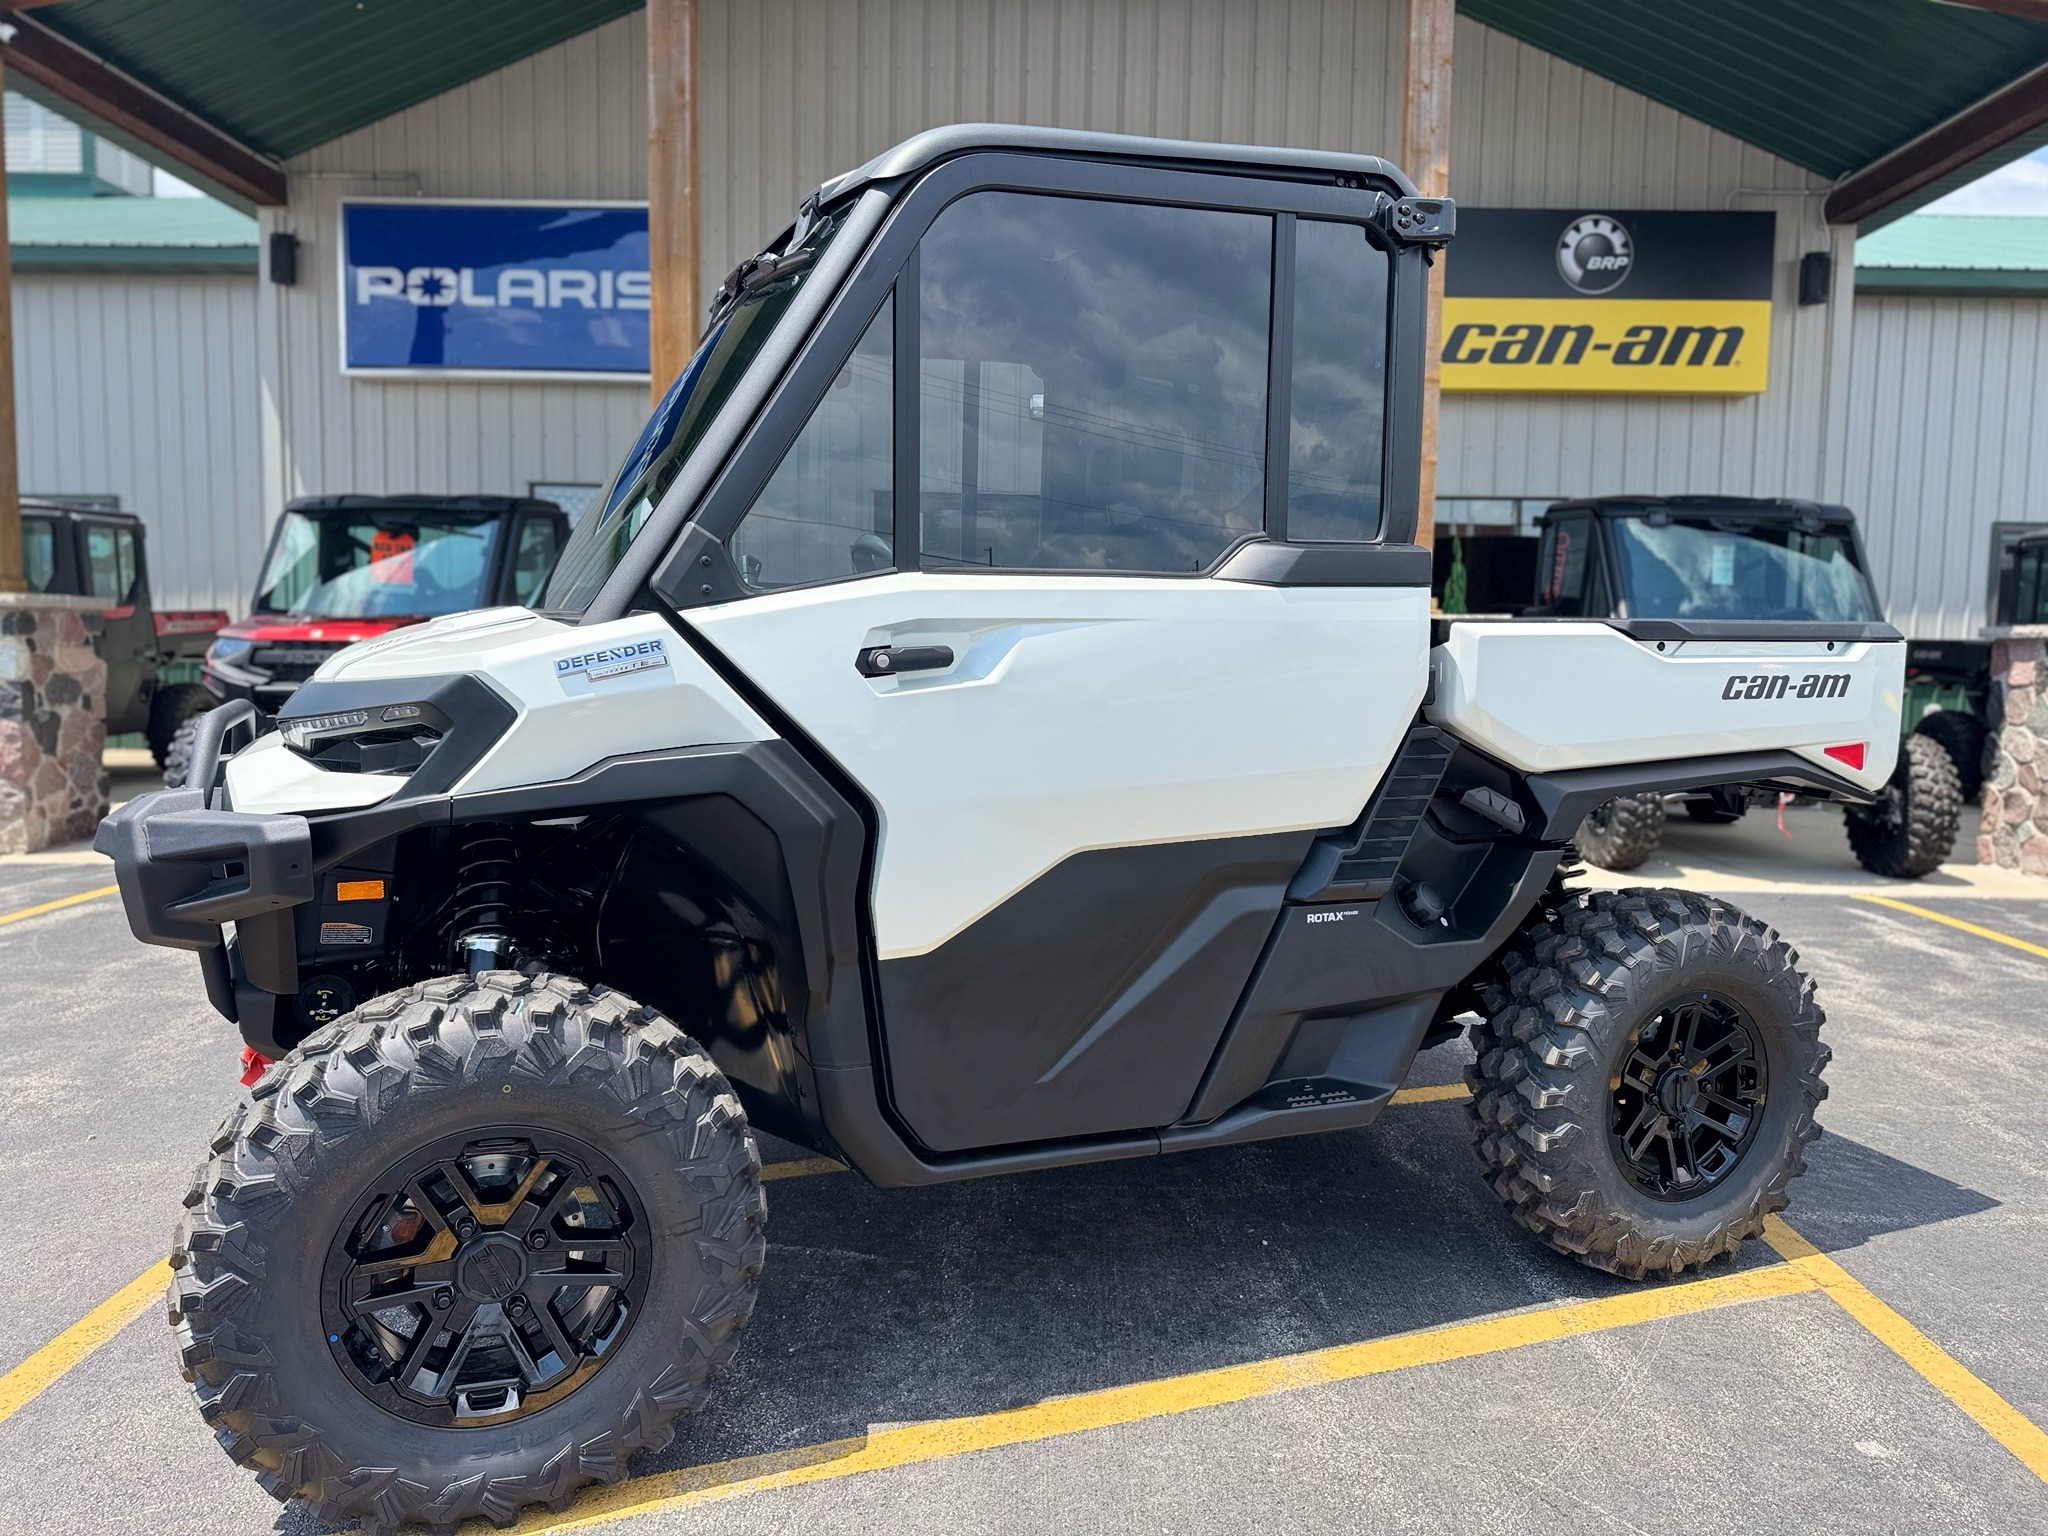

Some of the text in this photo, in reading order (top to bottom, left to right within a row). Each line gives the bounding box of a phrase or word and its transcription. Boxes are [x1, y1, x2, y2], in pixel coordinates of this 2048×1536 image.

[1586, 256, 1629, 270] BRP
[356, 266, 651, 309] POLARIS
[1441, 323, 1745, 366] can-am
[557, 640, 663, 671] DEFENDER
[1721, 674, 1852, 700] can-am
[1306, 911, 1344, 923] ROTAX
